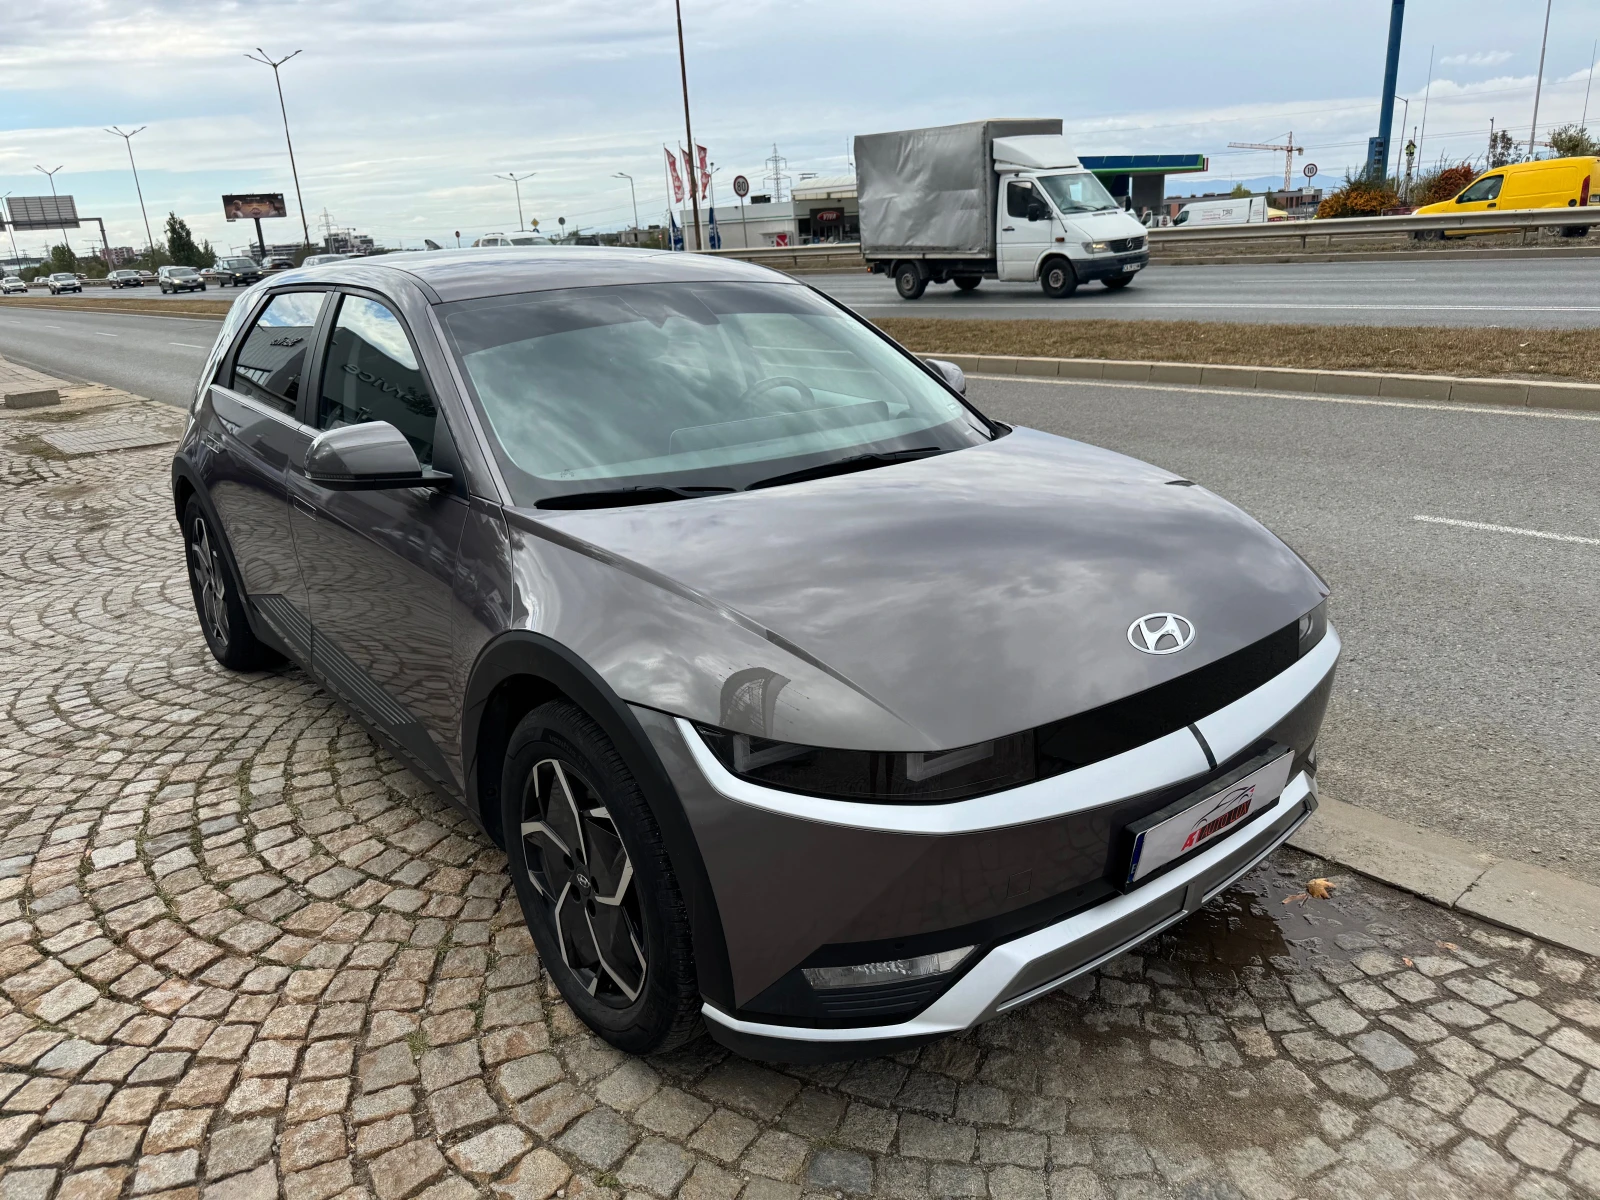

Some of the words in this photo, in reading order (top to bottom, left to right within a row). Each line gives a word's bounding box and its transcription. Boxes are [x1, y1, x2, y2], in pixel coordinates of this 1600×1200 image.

[1307, 166, 1315, 175] 10
[736, 181, 747, 192] 80
[823, 213, 837, 221] VIVA
[1201, 812, 1229, 839] AUTO
[1230, 798, 1252, 823] LUX
